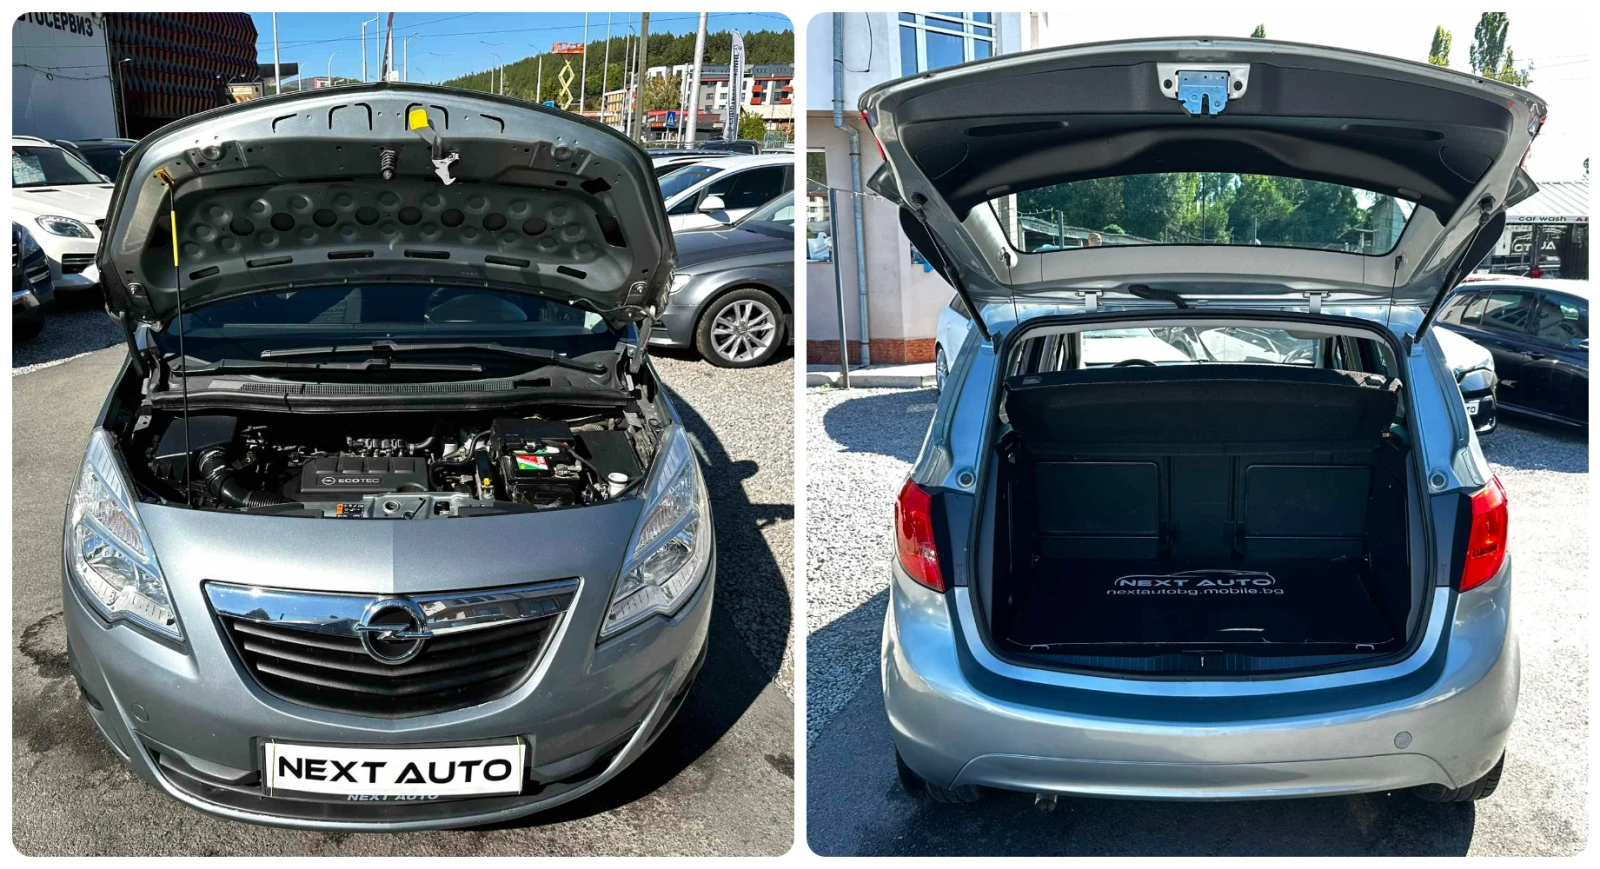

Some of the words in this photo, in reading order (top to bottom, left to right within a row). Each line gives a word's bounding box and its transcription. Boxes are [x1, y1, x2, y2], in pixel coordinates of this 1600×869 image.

[1119, 579, 1189, 587] NEXT
[1196, 578, 1272, 587] AUTO
[1106, 587, 1284, 596] nextautobg.mobile.bg
[278, 755, 388, 784] NEXT
[394, 758, 512, 785] AUTO
